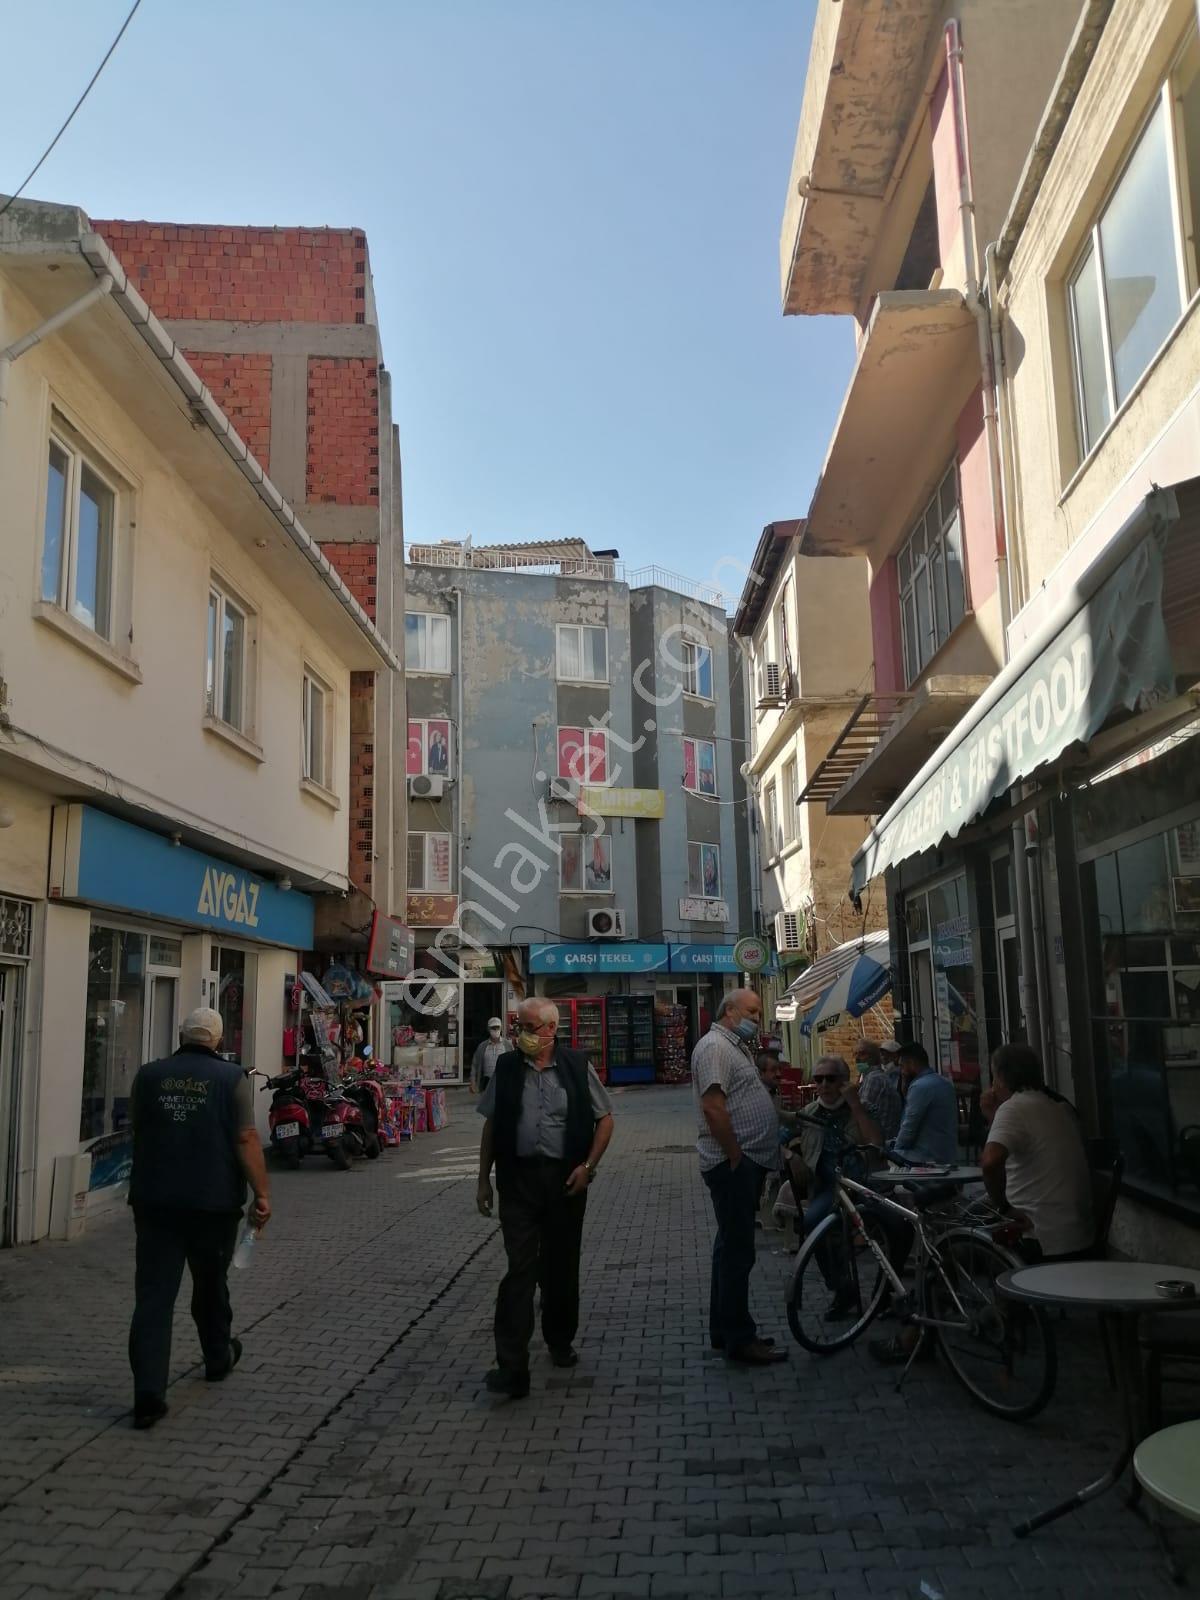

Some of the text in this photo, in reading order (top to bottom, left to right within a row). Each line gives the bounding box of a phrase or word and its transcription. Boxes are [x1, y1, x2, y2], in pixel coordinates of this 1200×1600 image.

[950, 764, 962, 813] &
[968, 633, 1092, 799] FASTFOOD
[197, 865, 260, 928] AYGAZ
[565, 953, 634, 965] ÇARŞI TEKEL
[692, 953, 713, 965] ÇARŞI
[173, 1110, 187, 1121] 55
